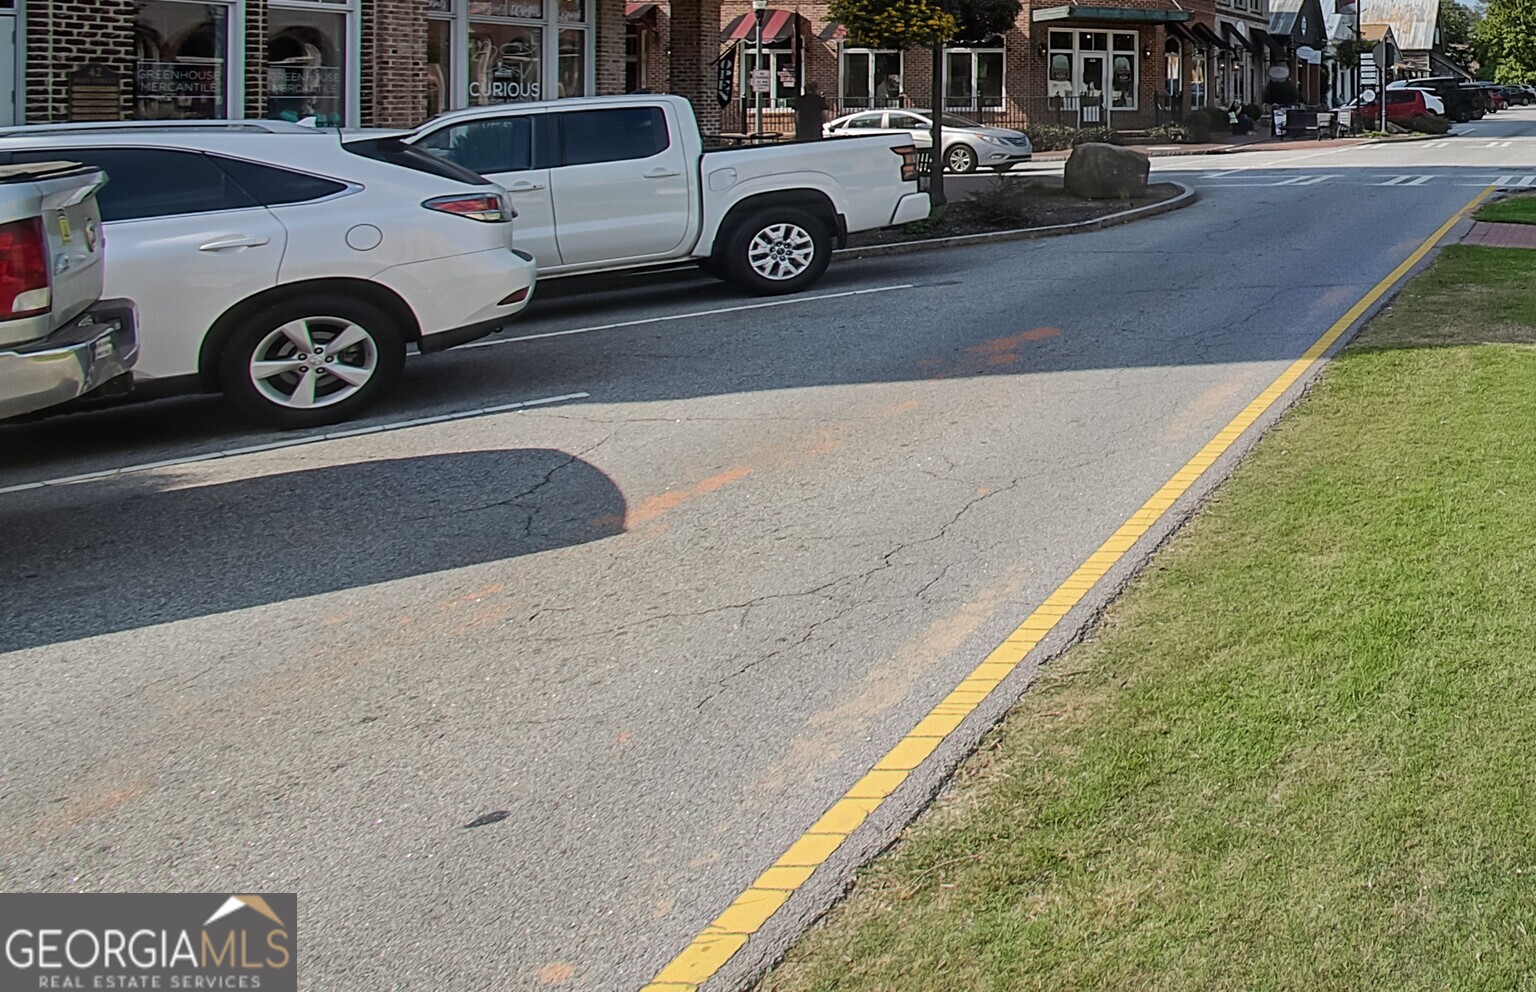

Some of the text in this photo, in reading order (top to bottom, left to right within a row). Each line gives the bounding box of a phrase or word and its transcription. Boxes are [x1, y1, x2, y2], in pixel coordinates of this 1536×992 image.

[88, 67, 102, 77] 42
[137, 69, 221, 80] GREENHOUSE
[140, 82, 217, 93] MERCANTILE
[469, 81, 541, 97] CURIOUS
